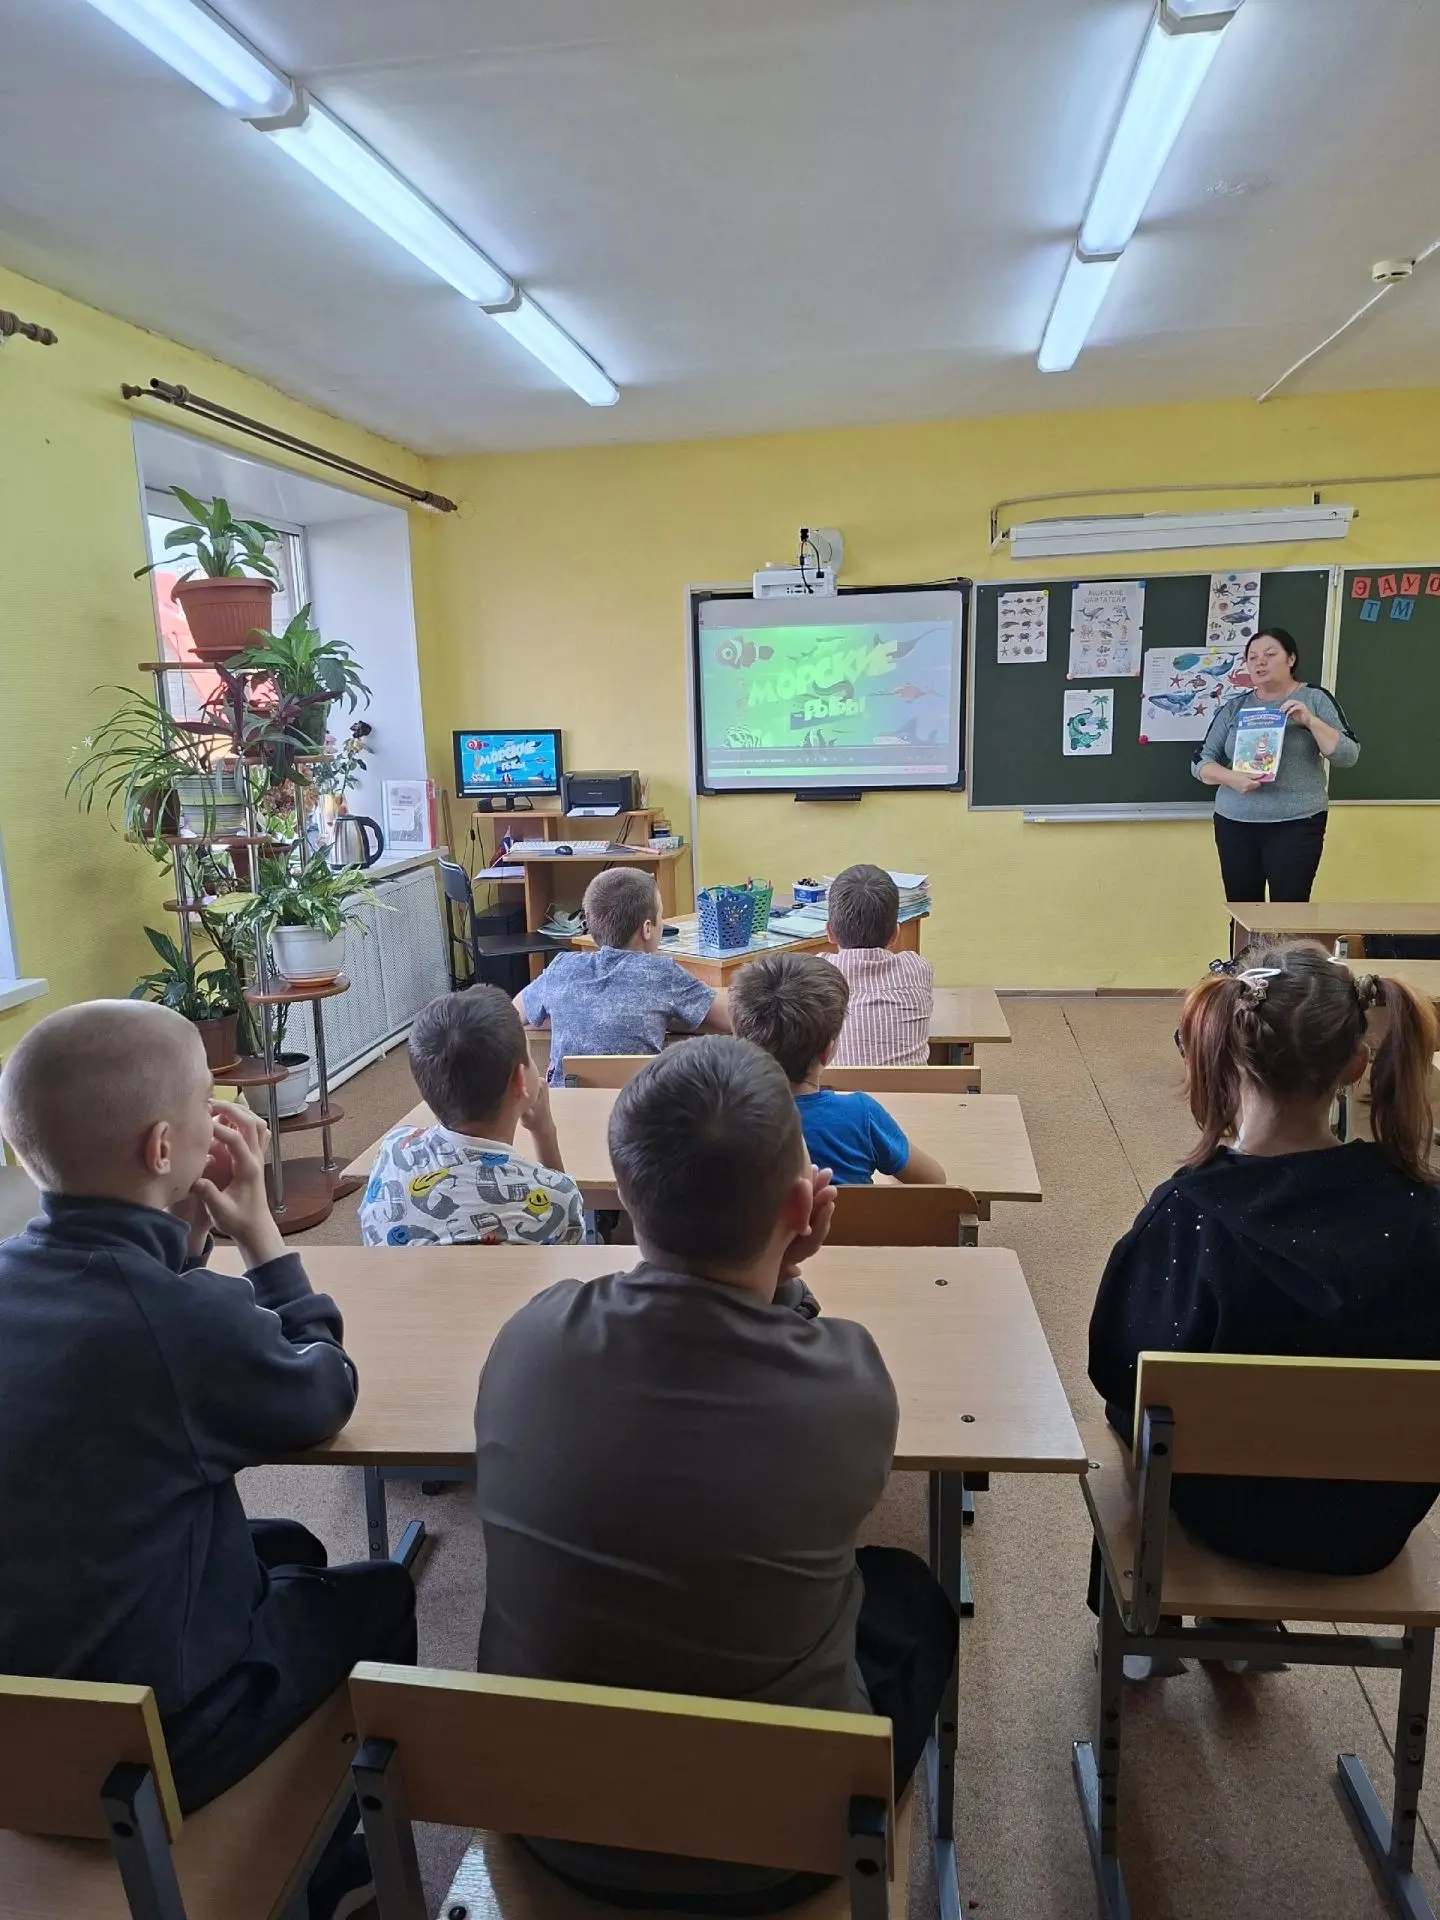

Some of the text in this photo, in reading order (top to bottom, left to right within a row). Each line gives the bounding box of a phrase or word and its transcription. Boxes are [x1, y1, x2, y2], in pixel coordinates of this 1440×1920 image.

[1354, 580, 1368, 596] Э
[1382, 578, 1394, 594] А
[1403, 576, 1418, 592] У
[1367, 601, 1411, 618] Т М
[747, 639, 898, 707] МОРСКИЕ
